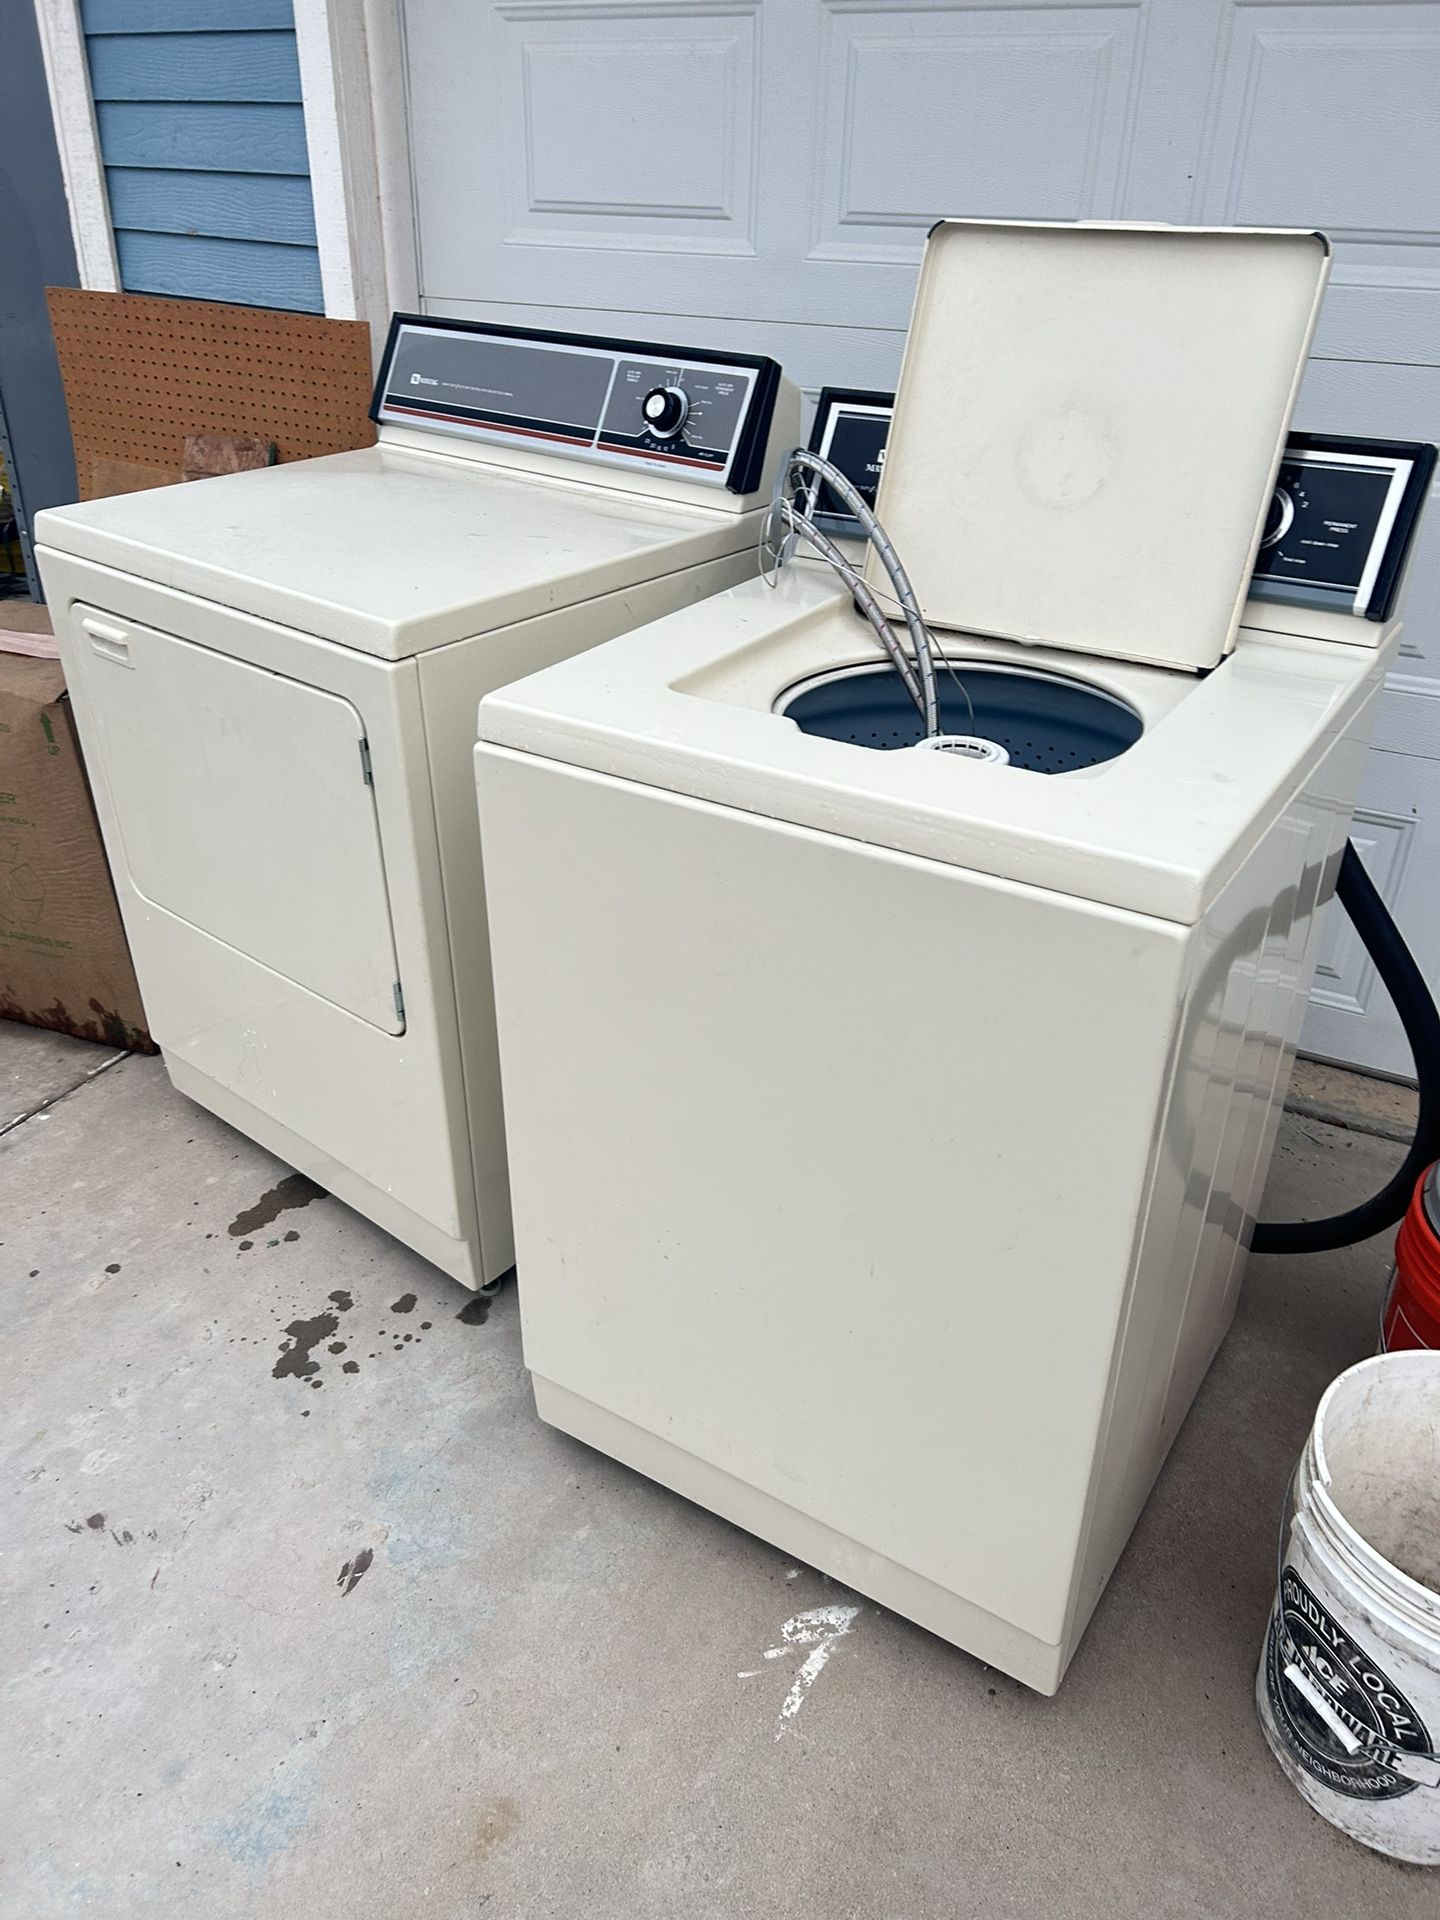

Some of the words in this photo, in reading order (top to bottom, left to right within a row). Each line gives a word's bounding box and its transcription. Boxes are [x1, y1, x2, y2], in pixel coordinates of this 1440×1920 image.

[1301, 501, 1310, 509] 2
[1283, 1578, 1346, 1647] PROUDLY
[1349, 1655, 1418, 1741] LOCAL
[1302, 1645, 1349, 1698] ACE
[1293, 1738, 1397, 1790] NEIGHBORHOOD
